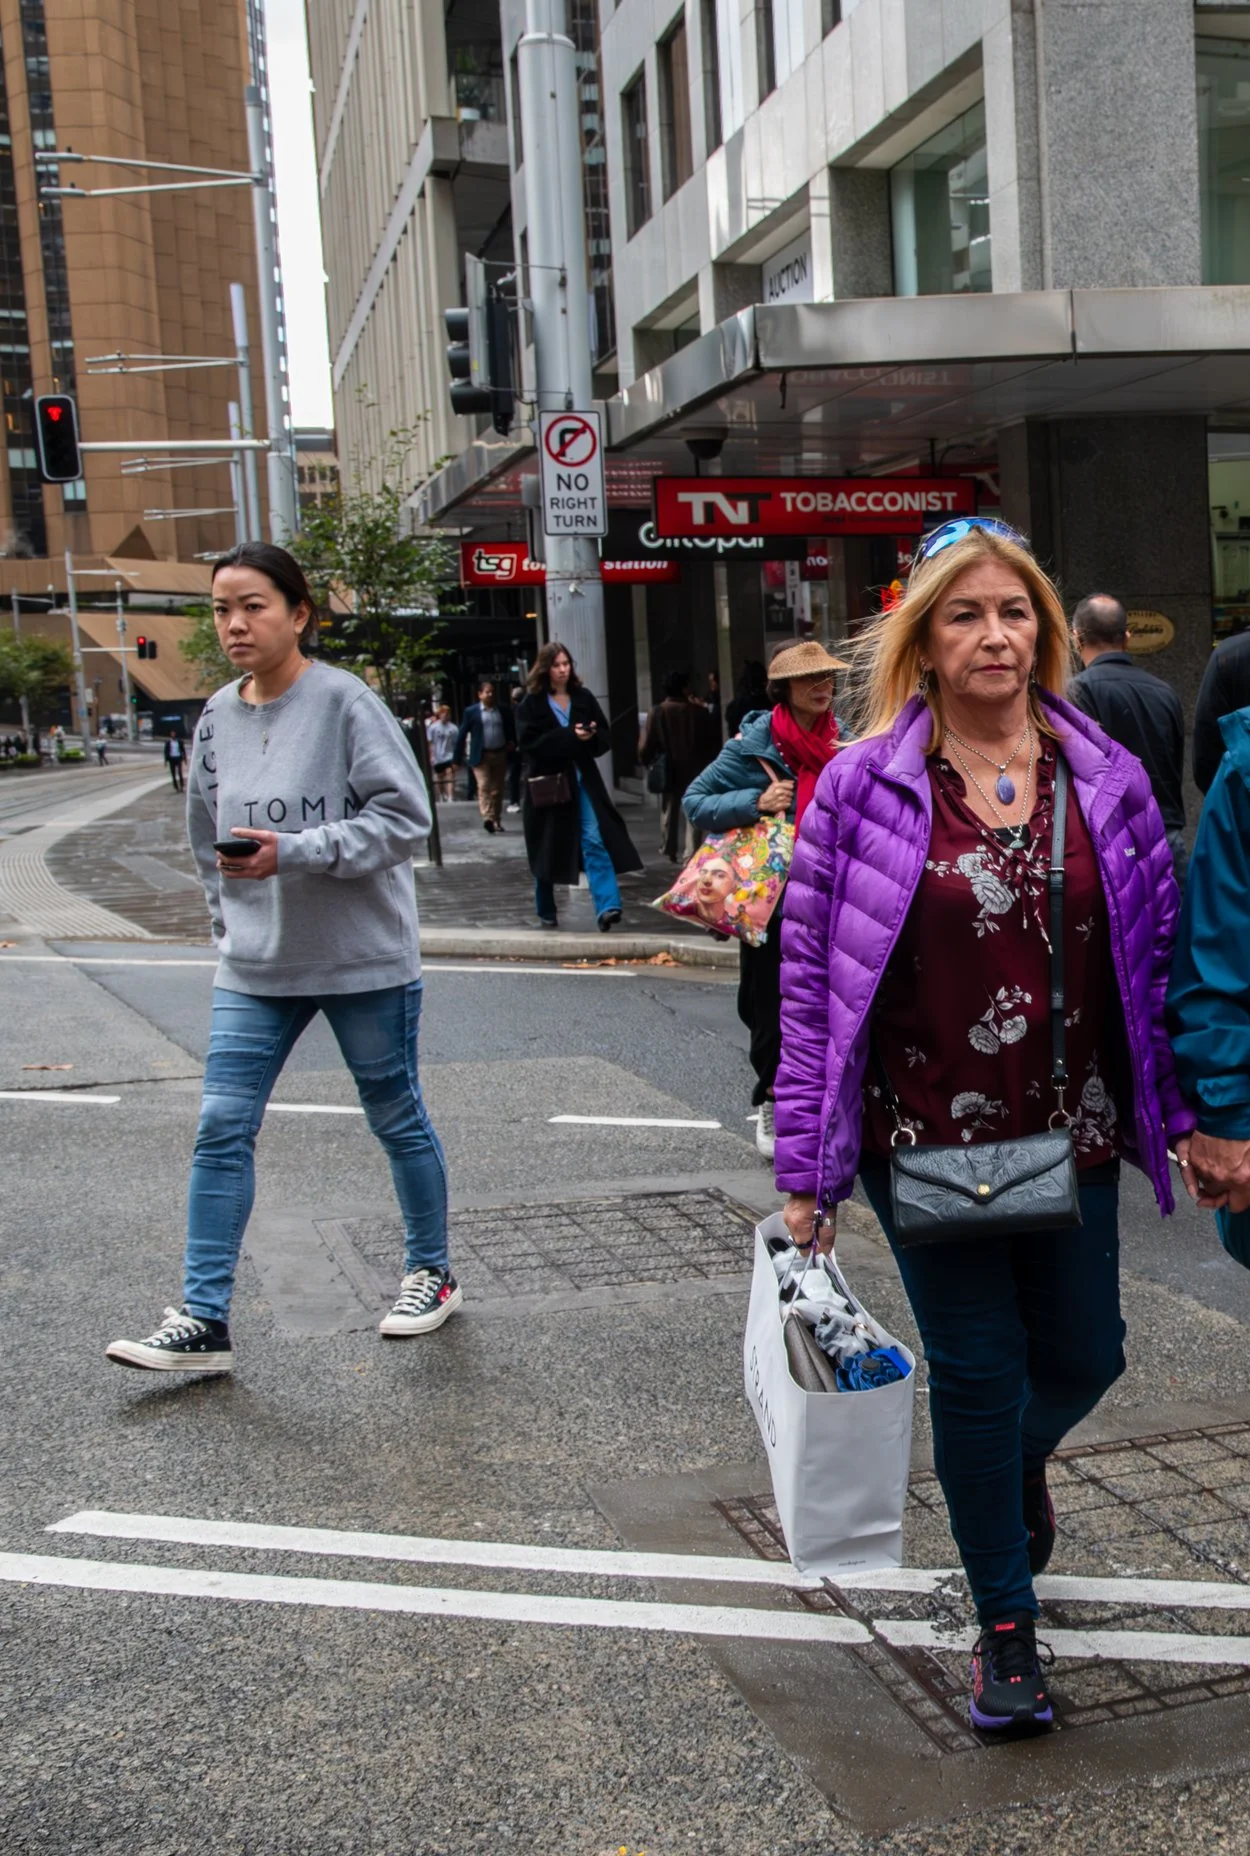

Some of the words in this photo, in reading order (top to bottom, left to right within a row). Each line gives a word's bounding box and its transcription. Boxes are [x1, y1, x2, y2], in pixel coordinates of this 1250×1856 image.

[768, 252, 808, 298] AUCTION
[556, 473, 589, 491] NO
[550, 497, 598, 510] RIGHT
[677, 492, 772, 525] TNT
[780, 491, 957, 512] TOBACCONIST
[553, 515, 598, 527] TURN
[474, 549, 517, 580] tsg
